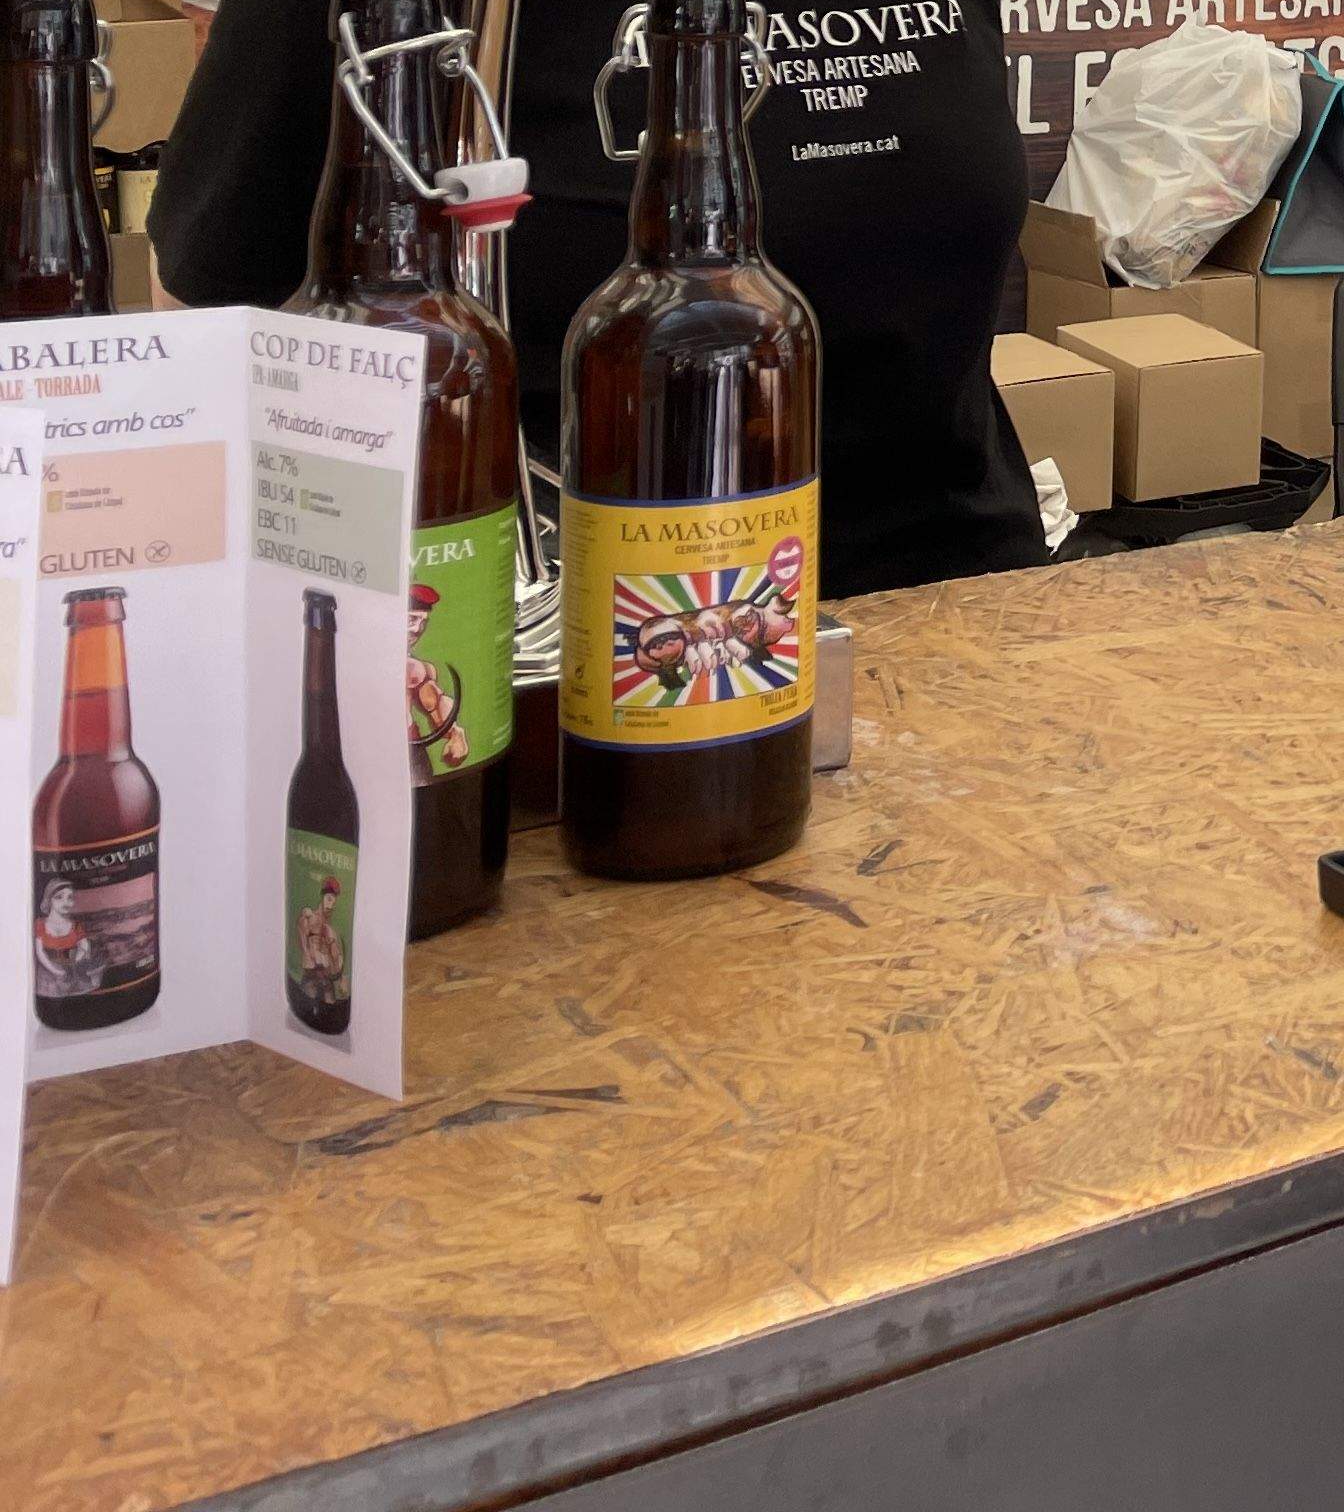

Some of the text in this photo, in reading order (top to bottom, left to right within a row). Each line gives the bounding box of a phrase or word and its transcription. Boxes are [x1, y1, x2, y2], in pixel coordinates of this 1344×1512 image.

[823, 50, 922, 81] ARTESANA
[800, 84, 870, 113] TREMP
[791, 134, 901, 162] LaMasovera.cat
[250, 331, 417, 390] COP DE FALÇ
[34, 373, 102, 399] TORRADA
[92, 411, 145, 436] amb
[257, 478, 277, 501] IBU
[280, 483, 295, 506] 54
[257, 508, 281, 532] EBC
[620, 503, 801, 543] LA MASOVERA
[40, 546, 135, 575] GLUTEN
[256, 537, 347, 580] SENSE GLUTEN
